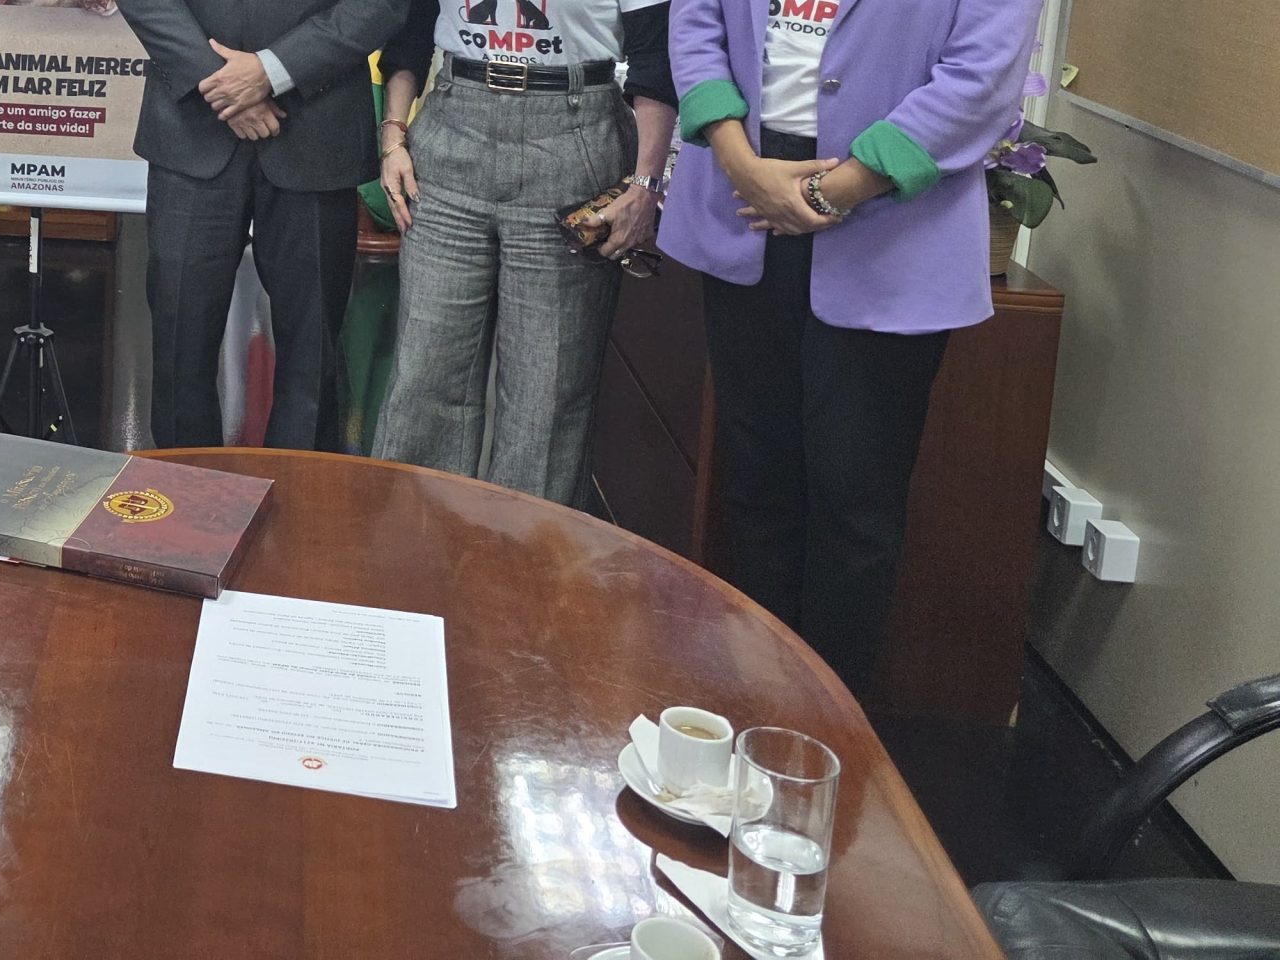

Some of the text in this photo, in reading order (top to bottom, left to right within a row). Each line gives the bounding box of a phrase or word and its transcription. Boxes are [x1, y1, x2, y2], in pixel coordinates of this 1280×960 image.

[458, 29, 563, 56] coMPet
[12, 76, 52, 96] LAR
[55, 78, 107, 98] FELIZ
[7, 106, 26, 116] um
[28, 106, 67, 119] amigo
[69, 108, 101, 119] fazer
[17, 120, 33, 131] da
[35, 123, 57, 132] sua
[59, 122, 90, 134] vida!
[11, 162, 66, 178] MPAM
[11, 182, 65, 192] AMAZONAS
